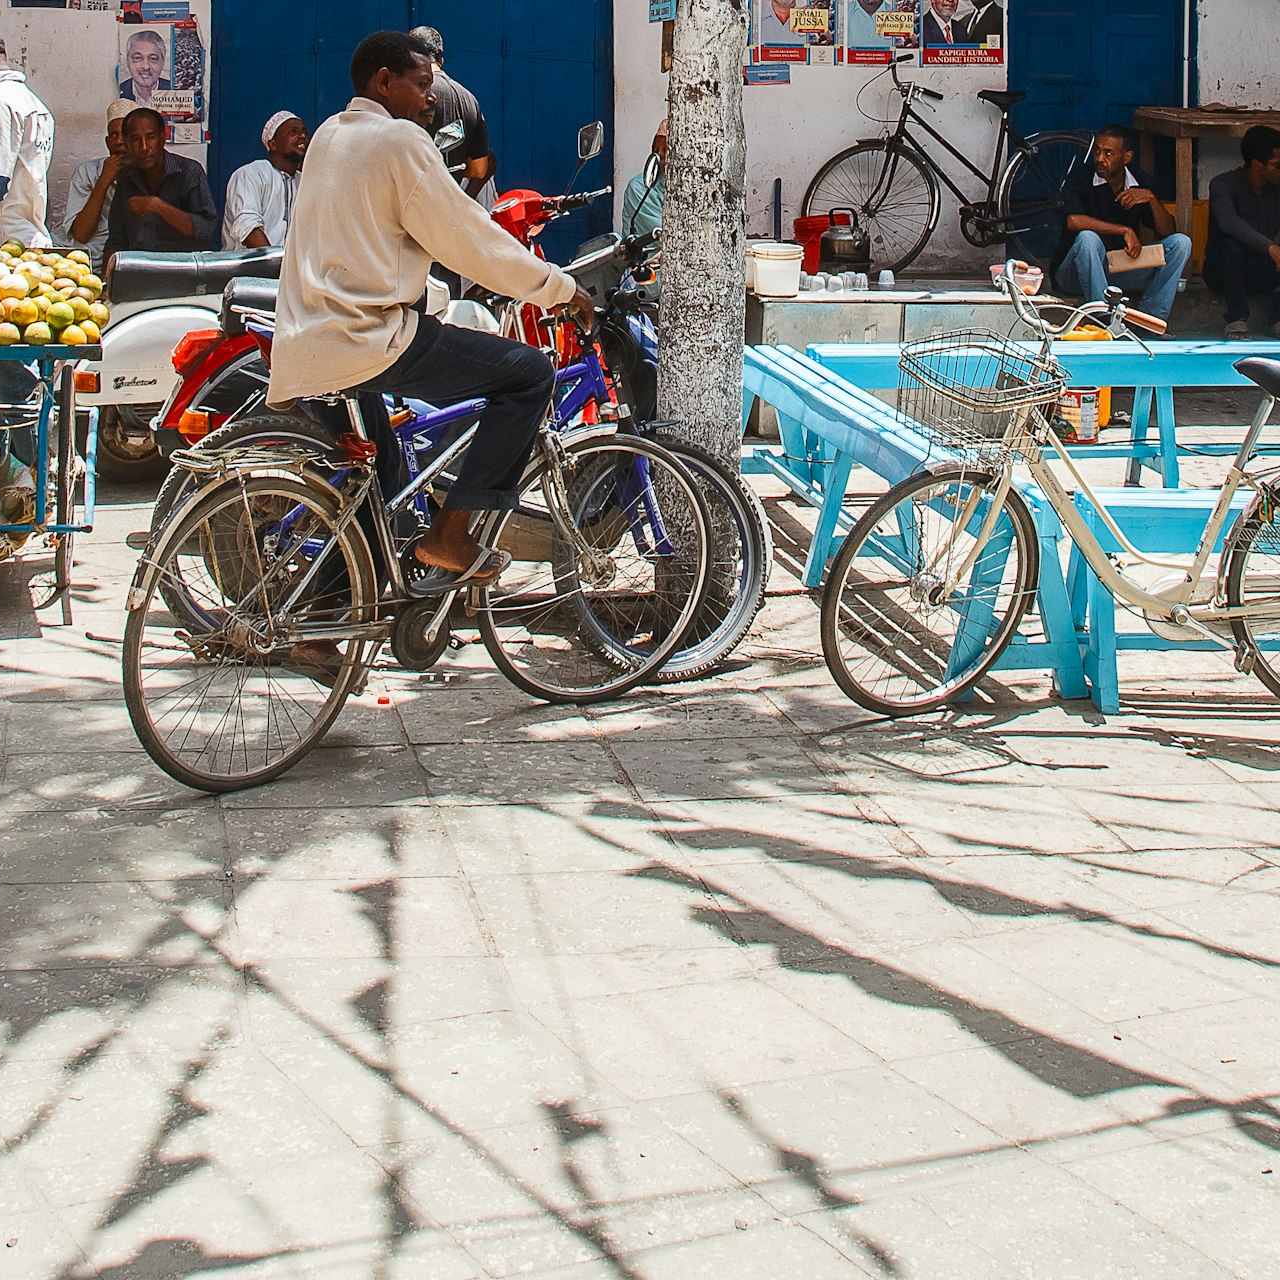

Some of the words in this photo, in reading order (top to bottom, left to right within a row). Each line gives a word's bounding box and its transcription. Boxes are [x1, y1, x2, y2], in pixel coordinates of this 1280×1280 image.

[794, 18, 824, 28] JUSSA
[877, 15, 913, 23] NASSOR
[152, 96, 193, 104] MOHAMED
